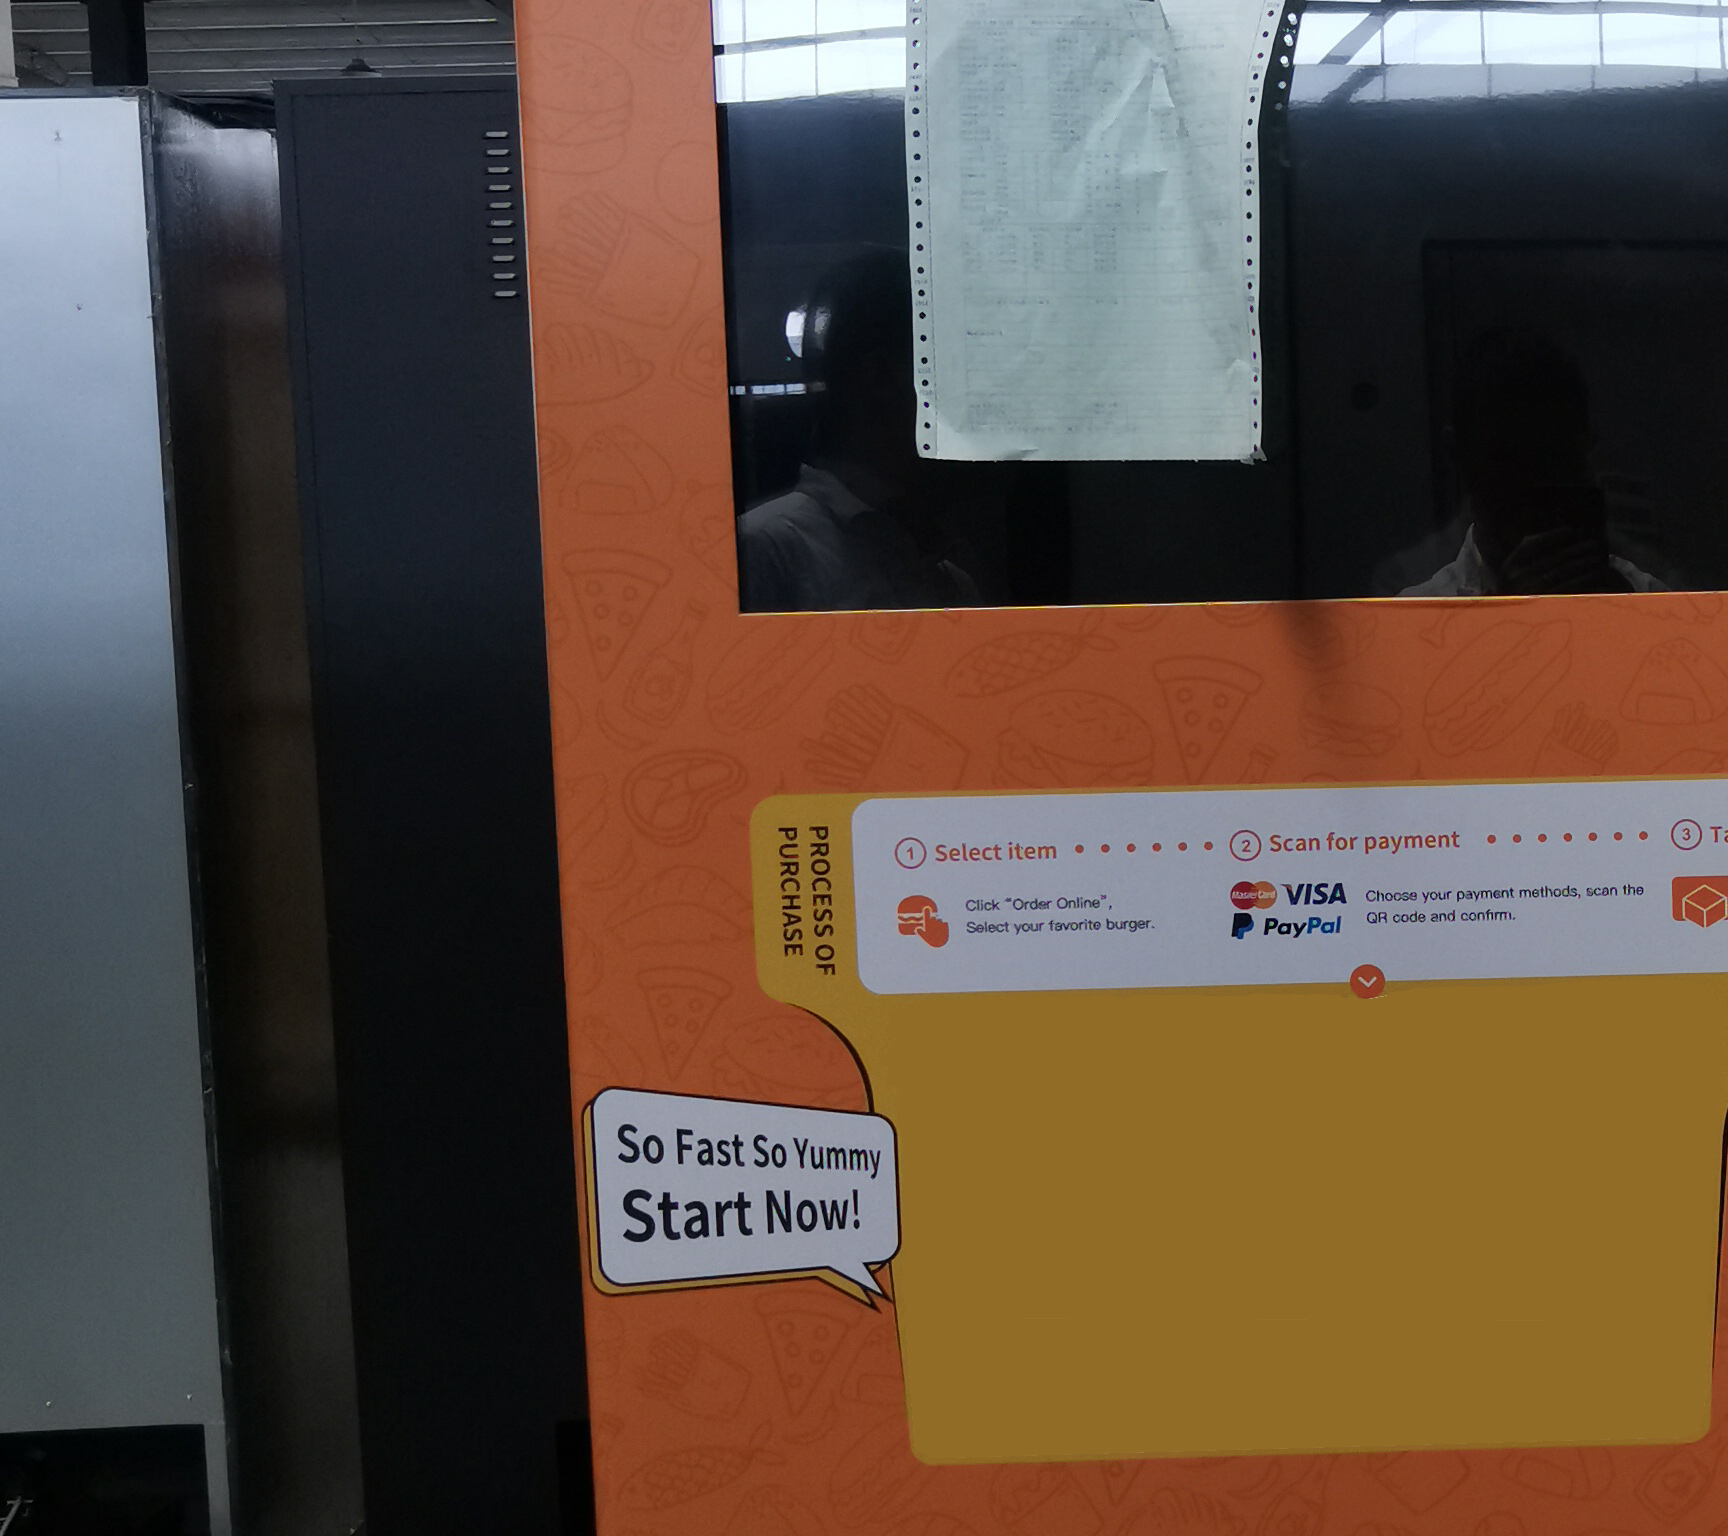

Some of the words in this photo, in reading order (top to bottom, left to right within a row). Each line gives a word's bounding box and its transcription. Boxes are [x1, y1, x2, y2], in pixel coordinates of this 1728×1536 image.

[935, 843, 1002, 863] Select
[1008, 840, 1057, 861] item
[1269, 834, 1320, 853] Scan
[1326, 832, 1358, 851] for
[1365, 831, 1460, 855] payment
[777, 827, 803, 957] PURCHASE
[809, 826, 834, 938] PROCESS
[1280, 882, 1347, 905] VISA
[1365, 889, 1417, 902] Choose
[1422, 891, 1452, 903] your
[1456, 888, 1515, 902] payment
[1519, 885, 1581, 899] methods,
[1586, 886, 1618, 897] scan
[1623, 883, 1645, 895] the
[965, 898, 1000, 912] Click
[1366, 911, 1388, 924] QR
[1392, 910, 1427, 923] code
[1430, 910, 1455, 923] and
[1460, 909, 1516, 922] confirm.
[966, 920, 1010, 934] Select
[1014, 921, 1044, 936] your
[1049, 919, 1101, 932] favorite
[1105, 917, 1155, 932] burger.
[1264, 916, 1342, 938] PayPal
[814, 944, 836, 976] OF
[617, 1123, 665, 1165] So
[675, 1128, 746, 1167] Fast
[753, 1134, 788, 1168] So
[793, 1137, 881, 1180] Yummy
[621, 1188, 754, 1243] Start
[765, 1188, 861, 1234] Now!
